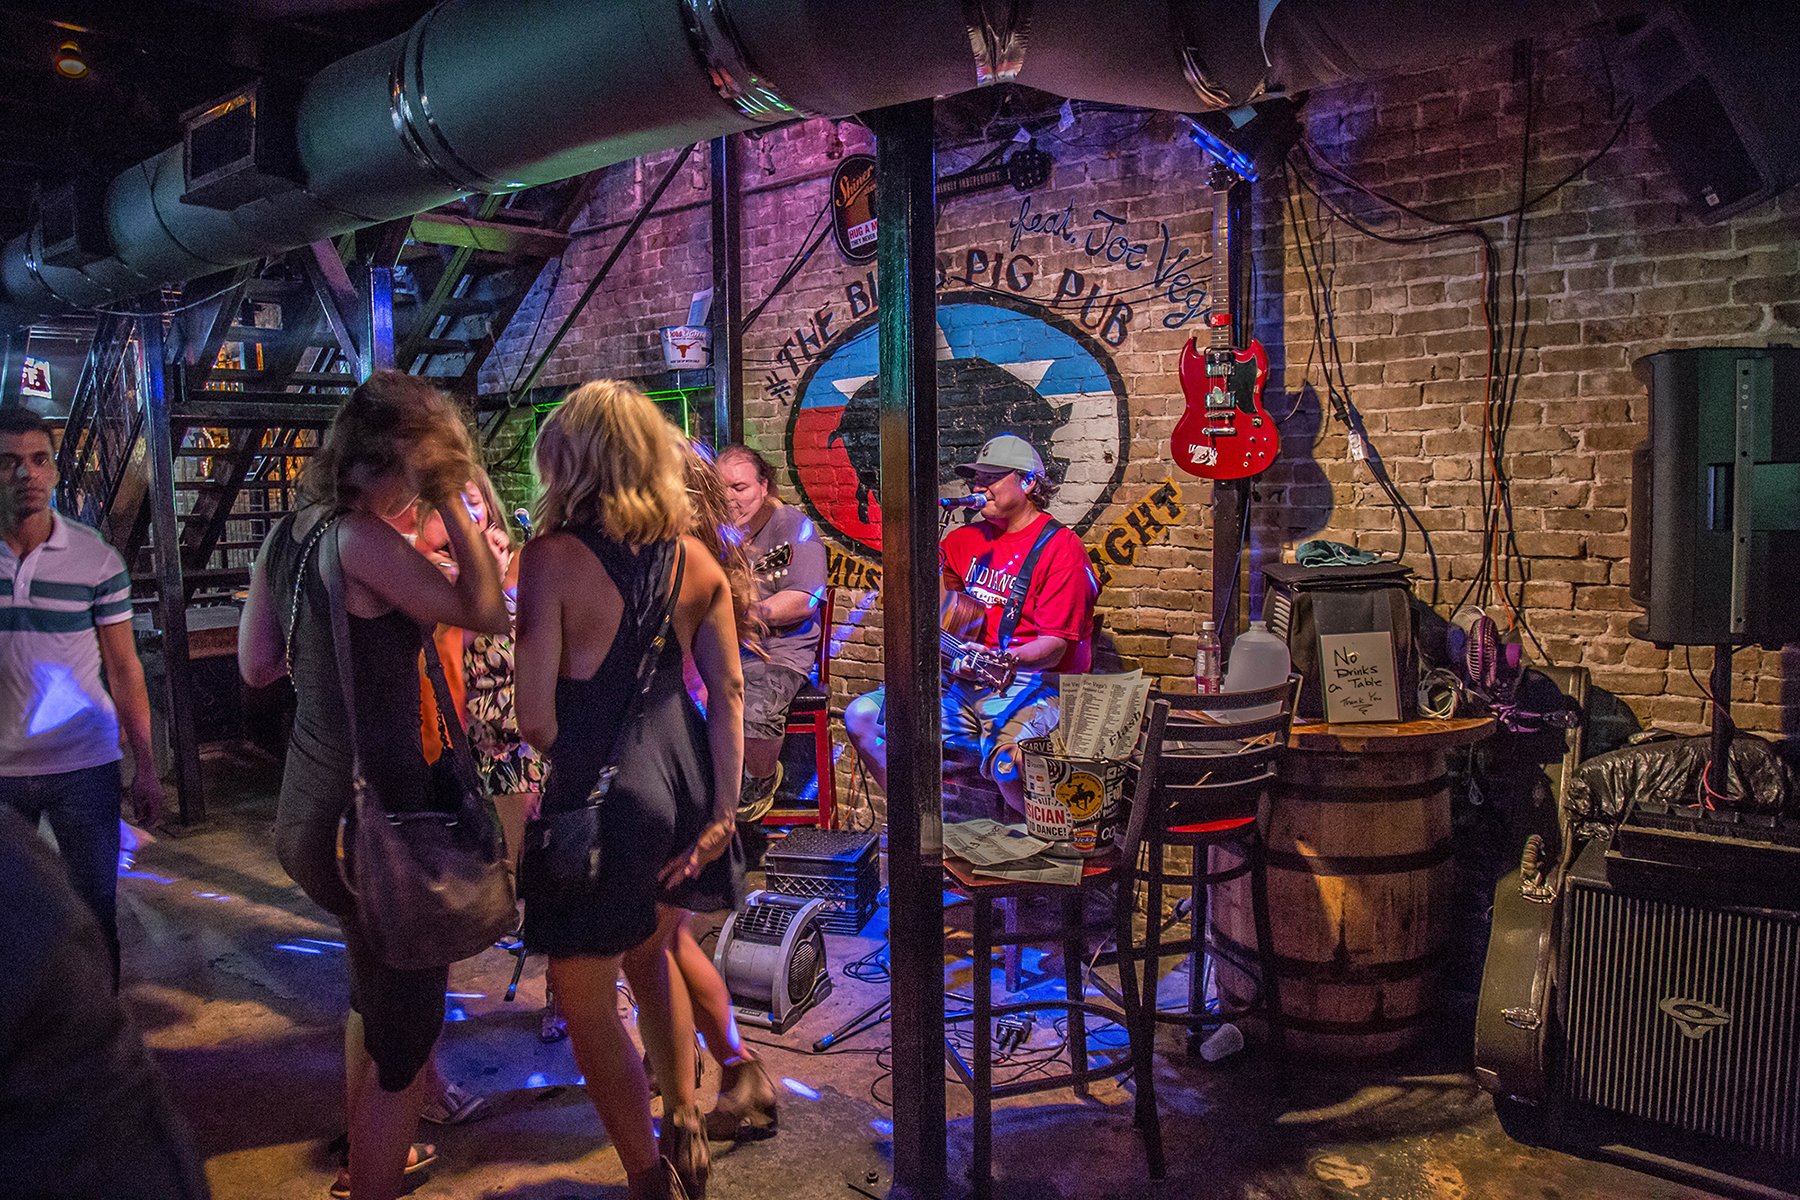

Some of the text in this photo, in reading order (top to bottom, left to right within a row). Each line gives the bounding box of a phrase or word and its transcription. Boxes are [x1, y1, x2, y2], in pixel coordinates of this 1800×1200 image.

[1009, 195, 1212, 330] feat. Joe Veg
[965, 248, 1036, 293] PIG
[1050, 267, 1133, 348] PUB
[825, 481, 1182, 593] MUS IGHT
[1334, 646, 1358, 666] No
[1333, 665, 1378, 678] Drinks
[1347, 676, 1382, 689] Table
[1036, 823, 1068, 837] DANCE!
